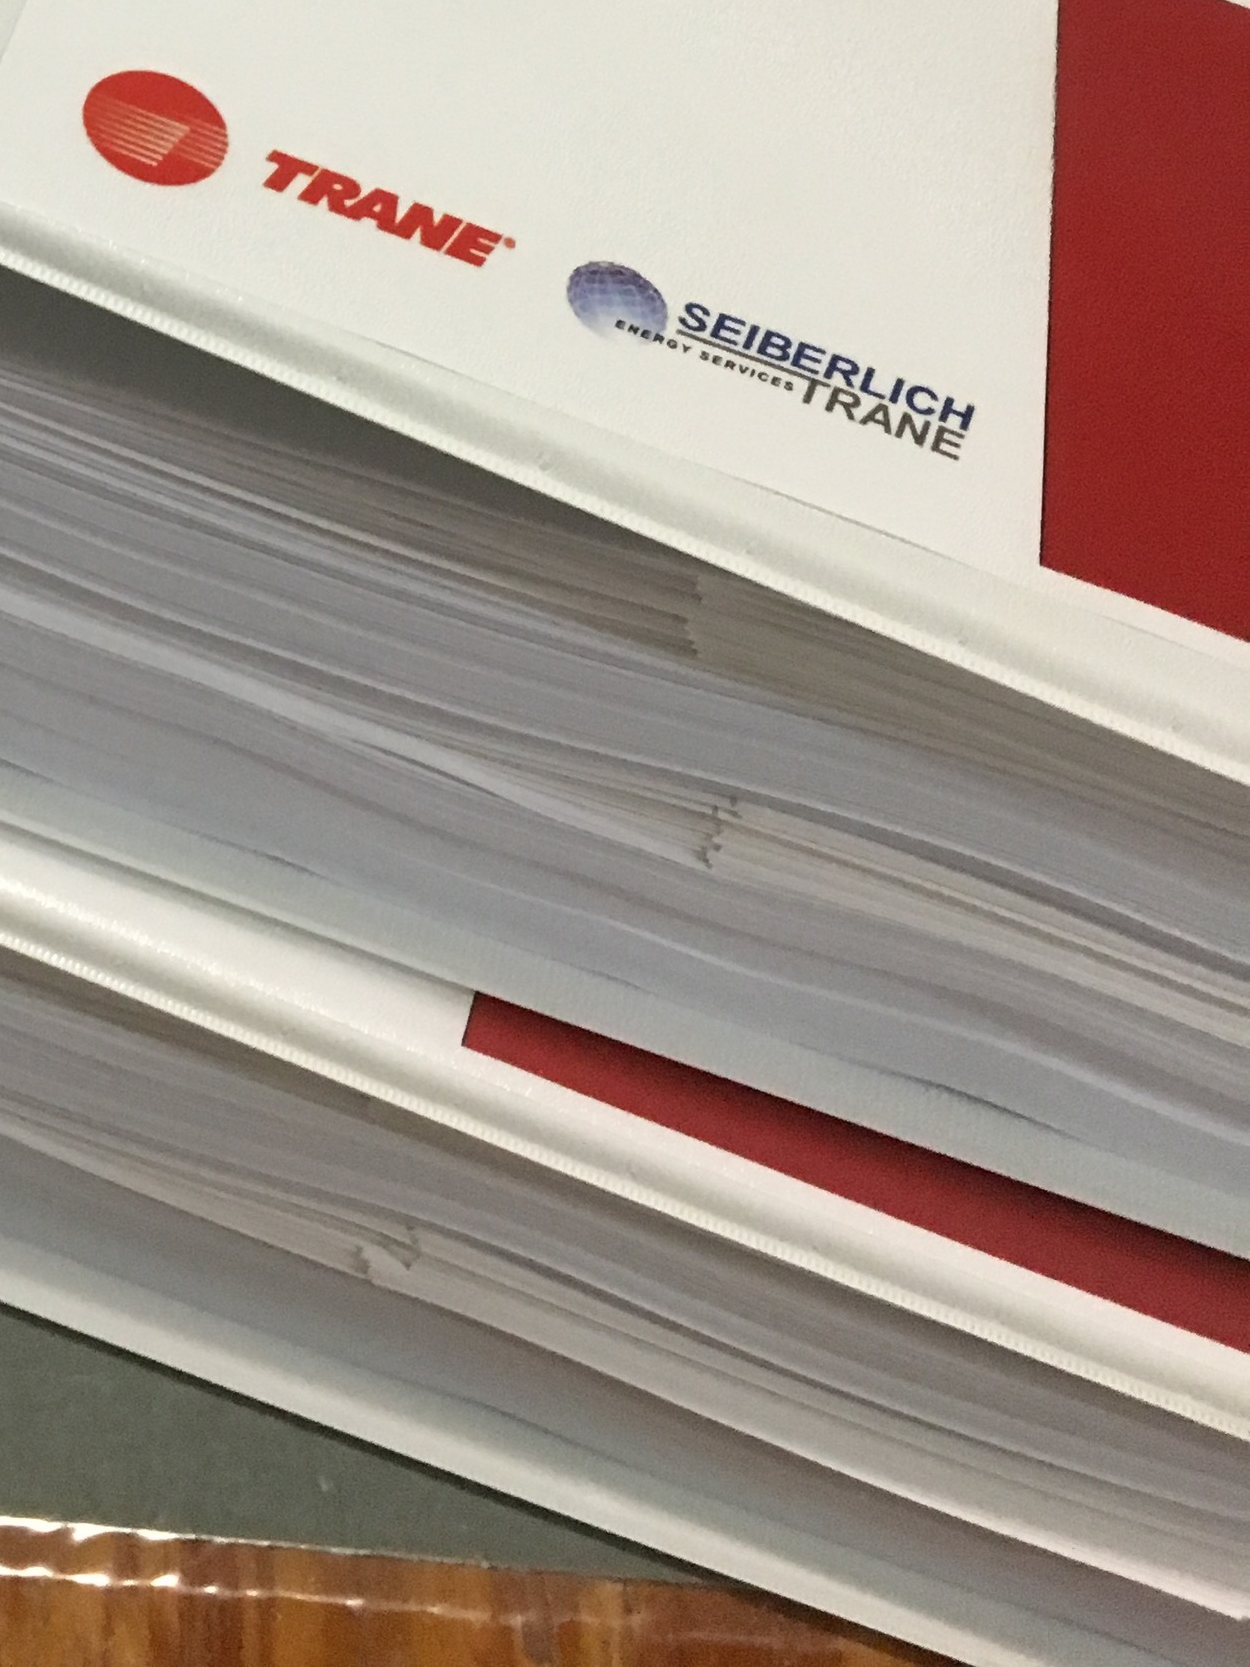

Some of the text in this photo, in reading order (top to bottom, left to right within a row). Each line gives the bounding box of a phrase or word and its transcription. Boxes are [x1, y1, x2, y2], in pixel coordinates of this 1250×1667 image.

[262, 149, 517, 269] TRANE
[614, 319, 795, 392] ENERGY SERVICES
[677, 301, 976, 432] SEIBERLICH
[801, 376, 967, 462] TRANE
